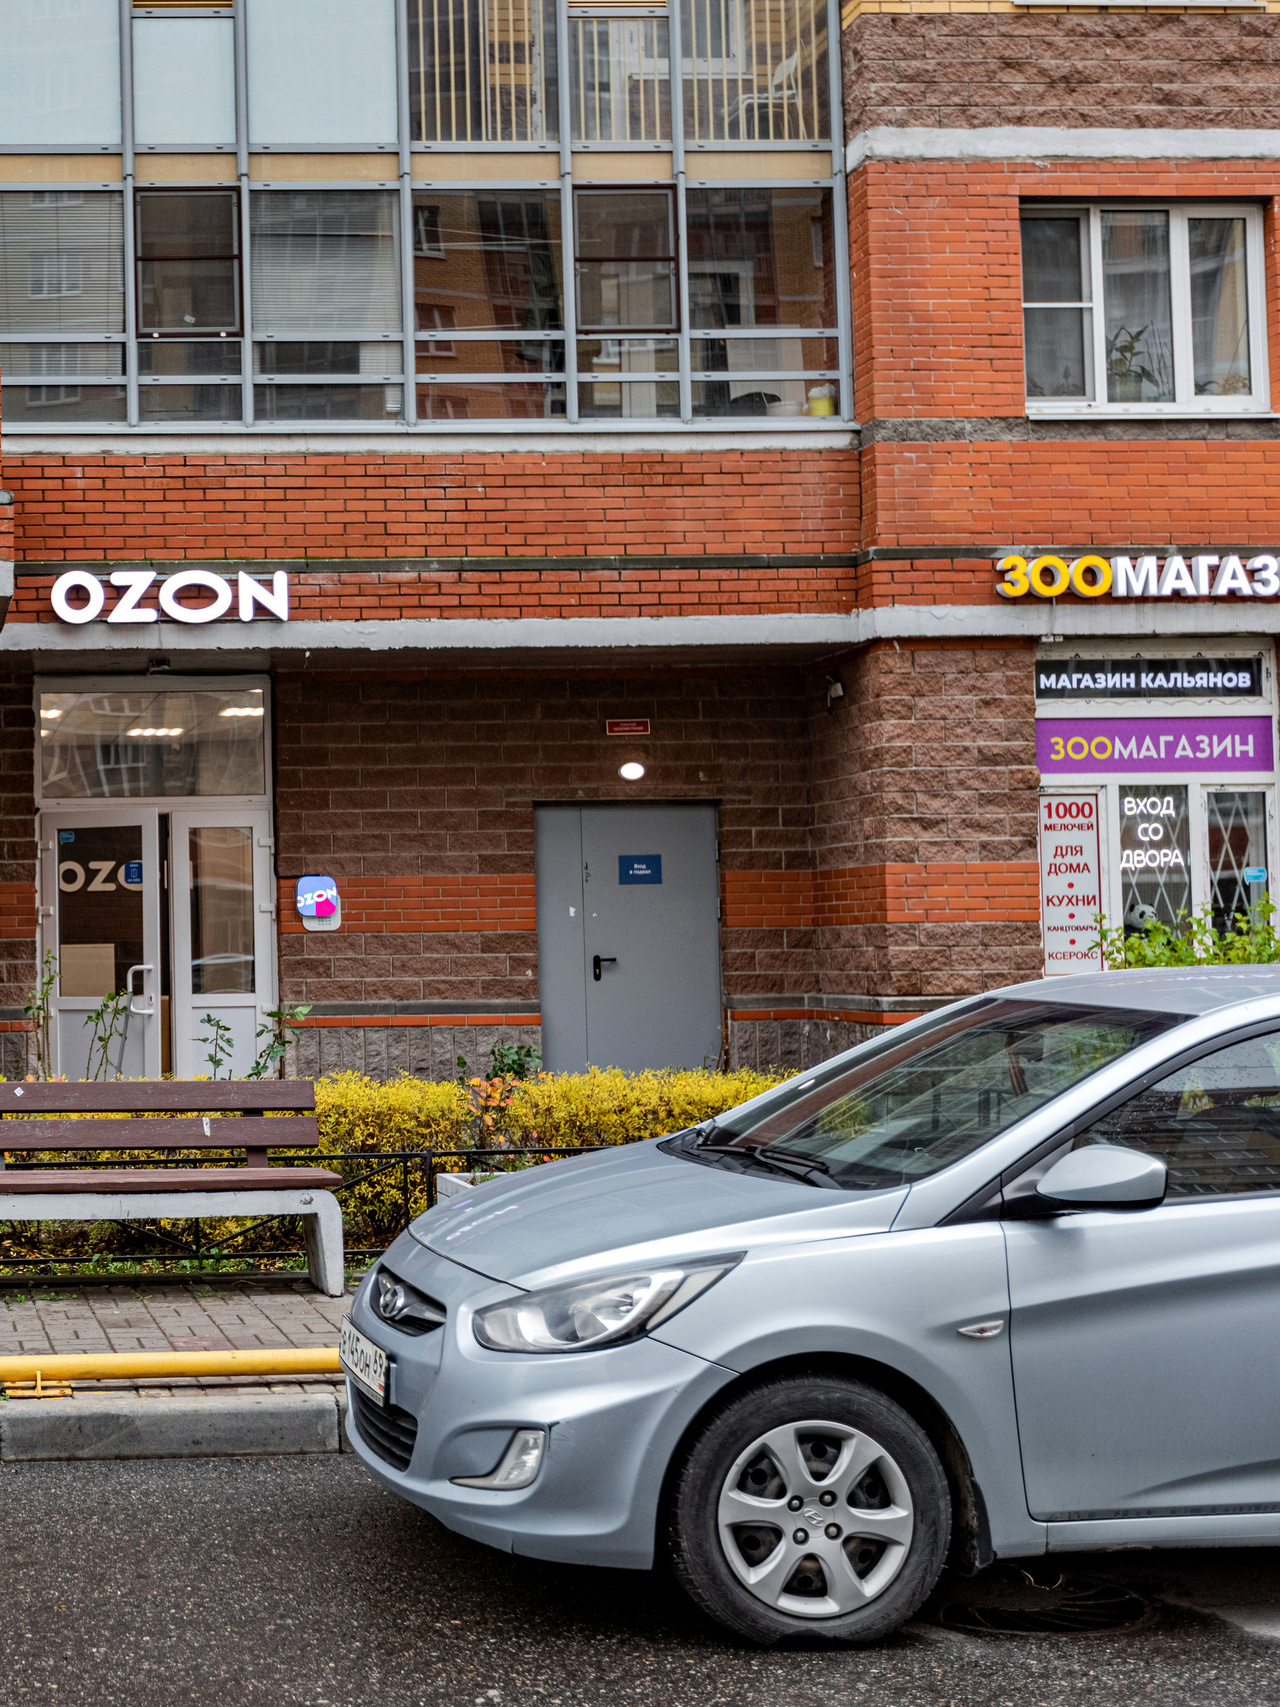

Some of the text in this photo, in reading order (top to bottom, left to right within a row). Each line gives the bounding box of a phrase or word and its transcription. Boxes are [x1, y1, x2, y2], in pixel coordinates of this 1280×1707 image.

[996, 554, 1280, 598] ЗООМАГАЗ
[51, 569, 289, 624] OZON
[1039, 672, 1251, 689] МАГАЗИН КАЛЬЯНОВ
[1050, 734, 1254, 760] ЗООМАГАЗИН
[1043, 801, 1093, 819] 1000
[1123, 796, 1175, 817] ВХОД
[1043, 821, 1094, 832] МЕЛОЧЕЙ
[1137, 822, 1164, 841] СО
[1053, 845, 1083, 859] ДЛЯ
[1120, 848, 1185, 871] ДВОРА
[1047, 862, 1091, 877] ДОМА
[297, 886, 337, 908] OZON
[1046, 894, 1097, 907] КУХНИ
[1047, 925, 1098, 933] КАНЦТОВАРЫ
[1048, 951, 1098, 961] КСЕРОКС
